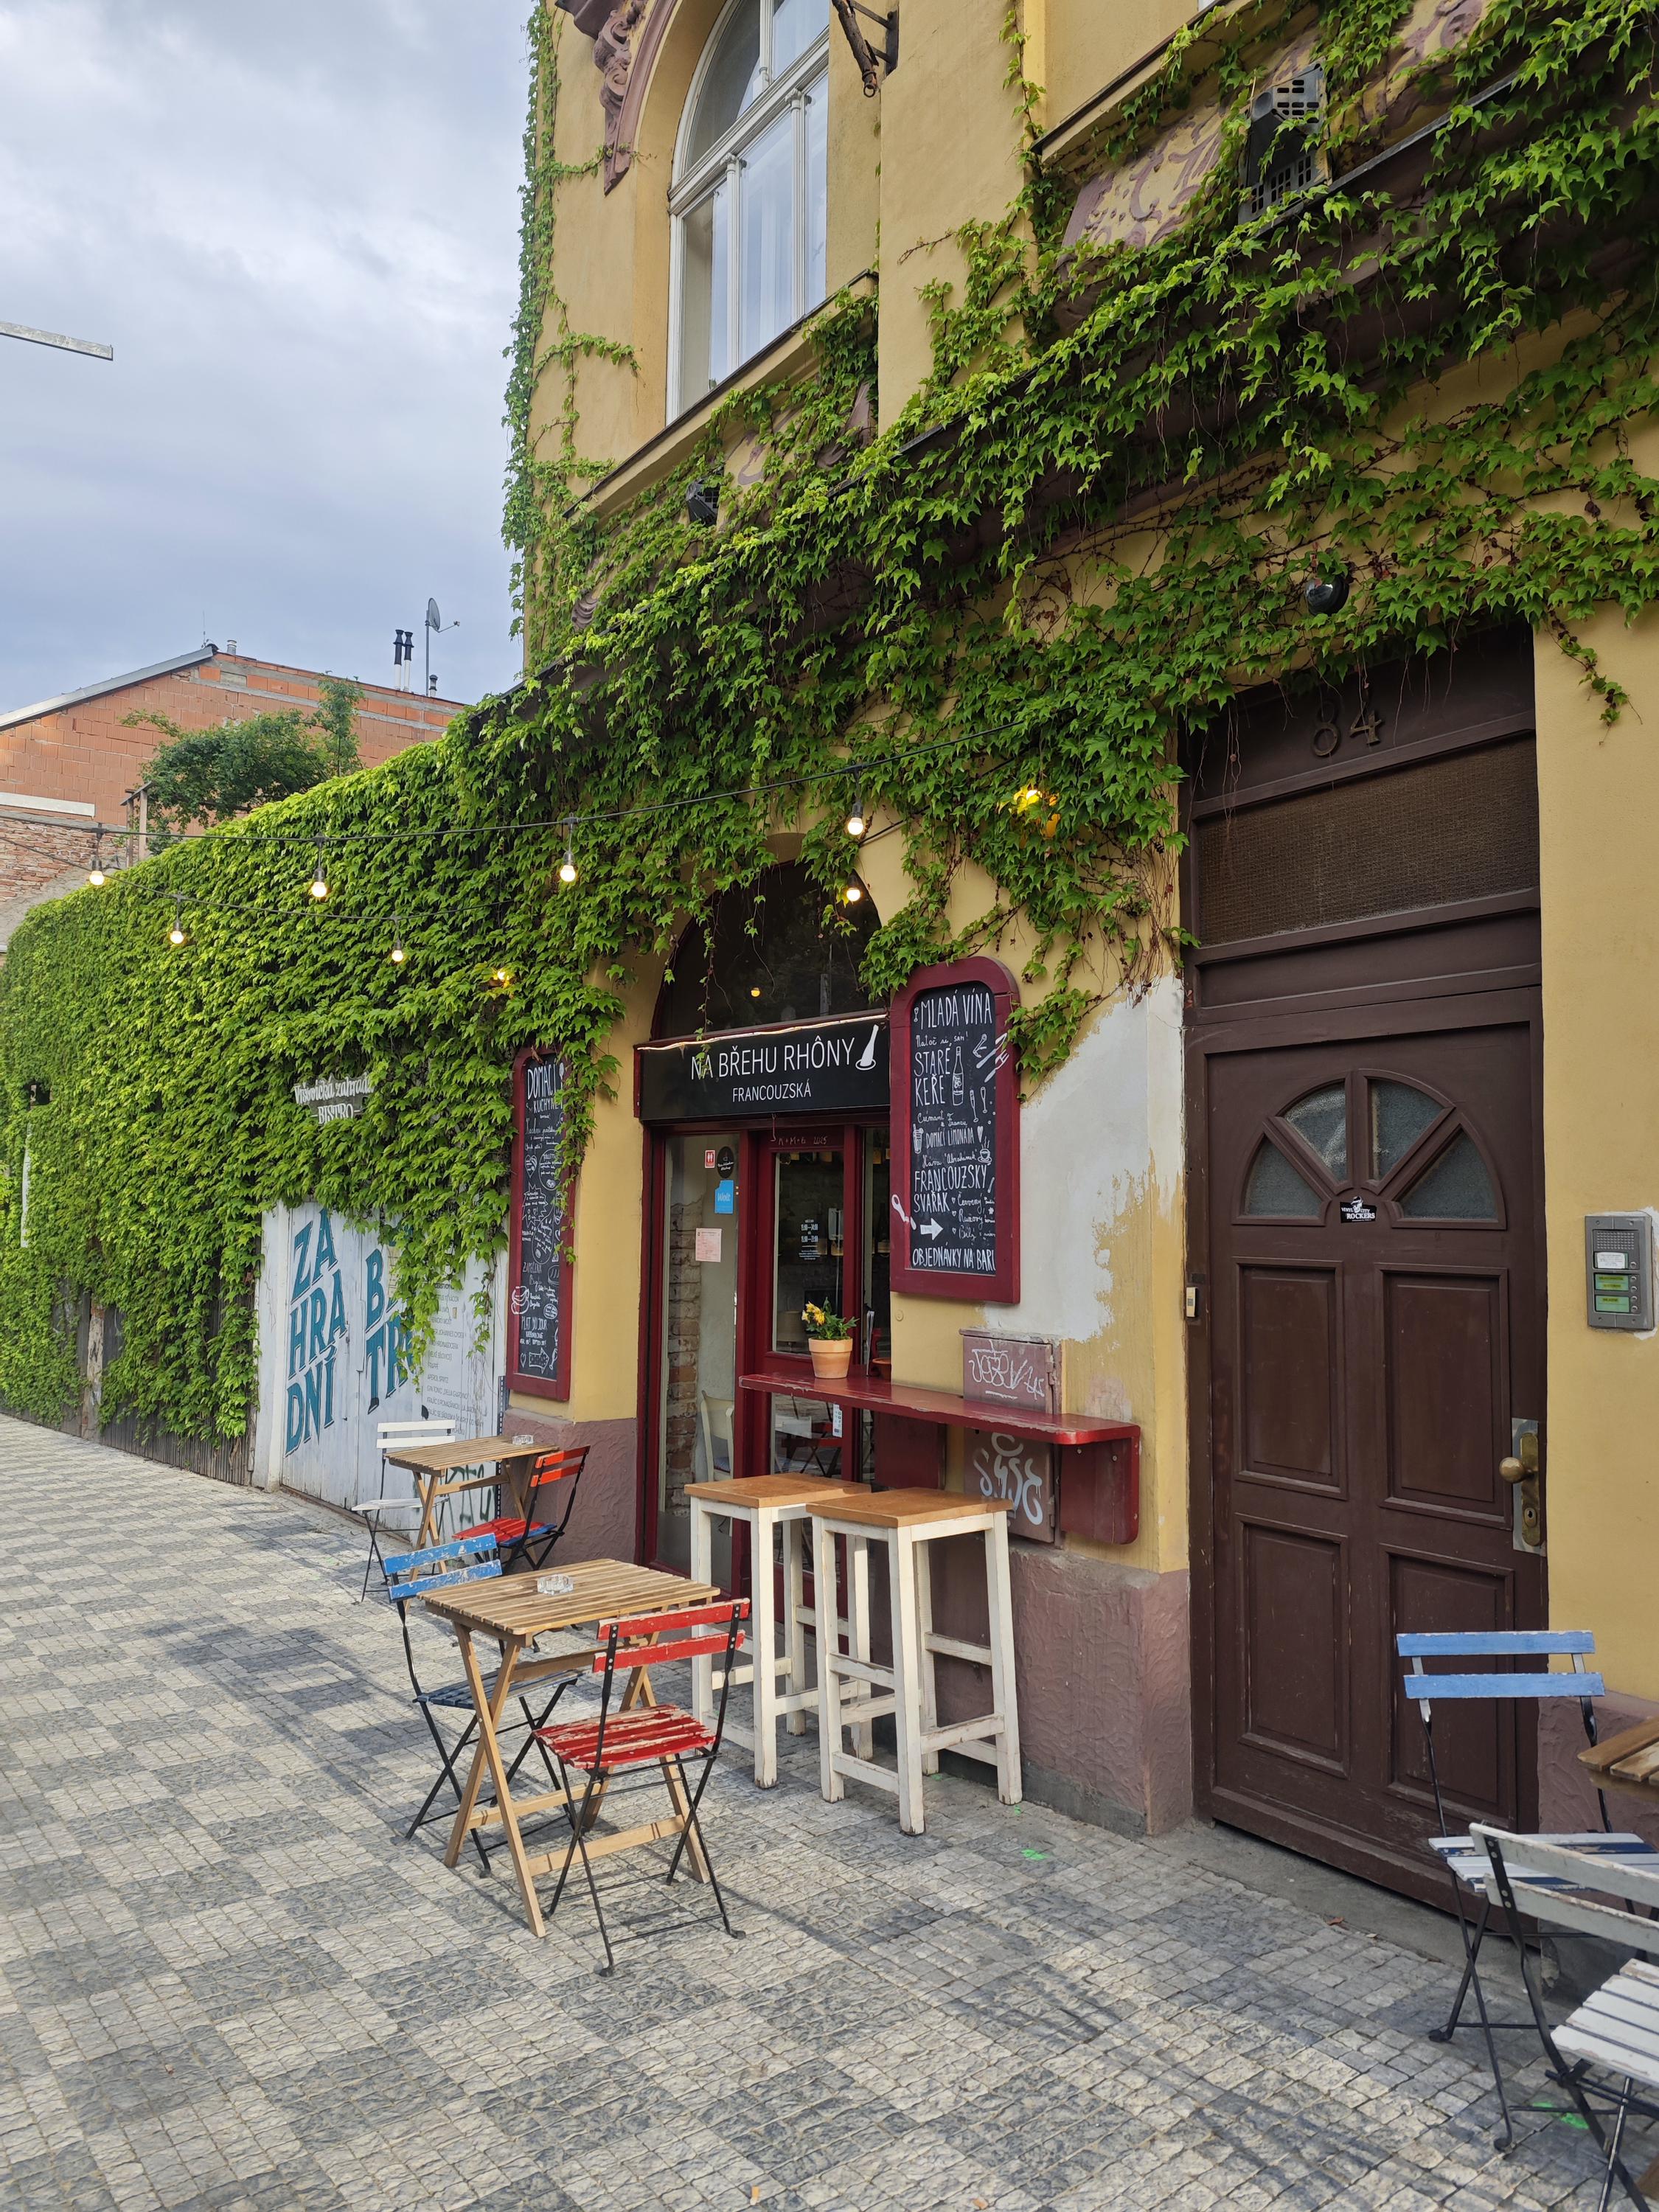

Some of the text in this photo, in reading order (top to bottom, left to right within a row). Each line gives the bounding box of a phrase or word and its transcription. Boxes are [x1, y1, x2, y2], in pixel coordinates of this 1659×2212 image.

[921, 988, 992, 1029] MLADÁ VÍNA
[691, 1035, 855, 1080] NA BŘEHU RHÔNY
[914, 1043, 952, 1077] STARÉ
[527, 1058, 556, 1100] DOMÁCÍ
[732, 1079, 811, 1102] FRANCOUZSKÁ
[915, 1074, 945, 1107] KEŘE
[925, 1126, 974, 1149] DOMÁCÍ LIMONÁDA
[914, 1162, 991, 1192] FRANCOUZSKÝ
[291, 1208, 338, 1304] ZA
[912, 1241, 961, 1268] OBJEDNÁVKY
[288, 1268, 347, 1380] HRA
[285, 1345, 337, 1458] DNÍ
